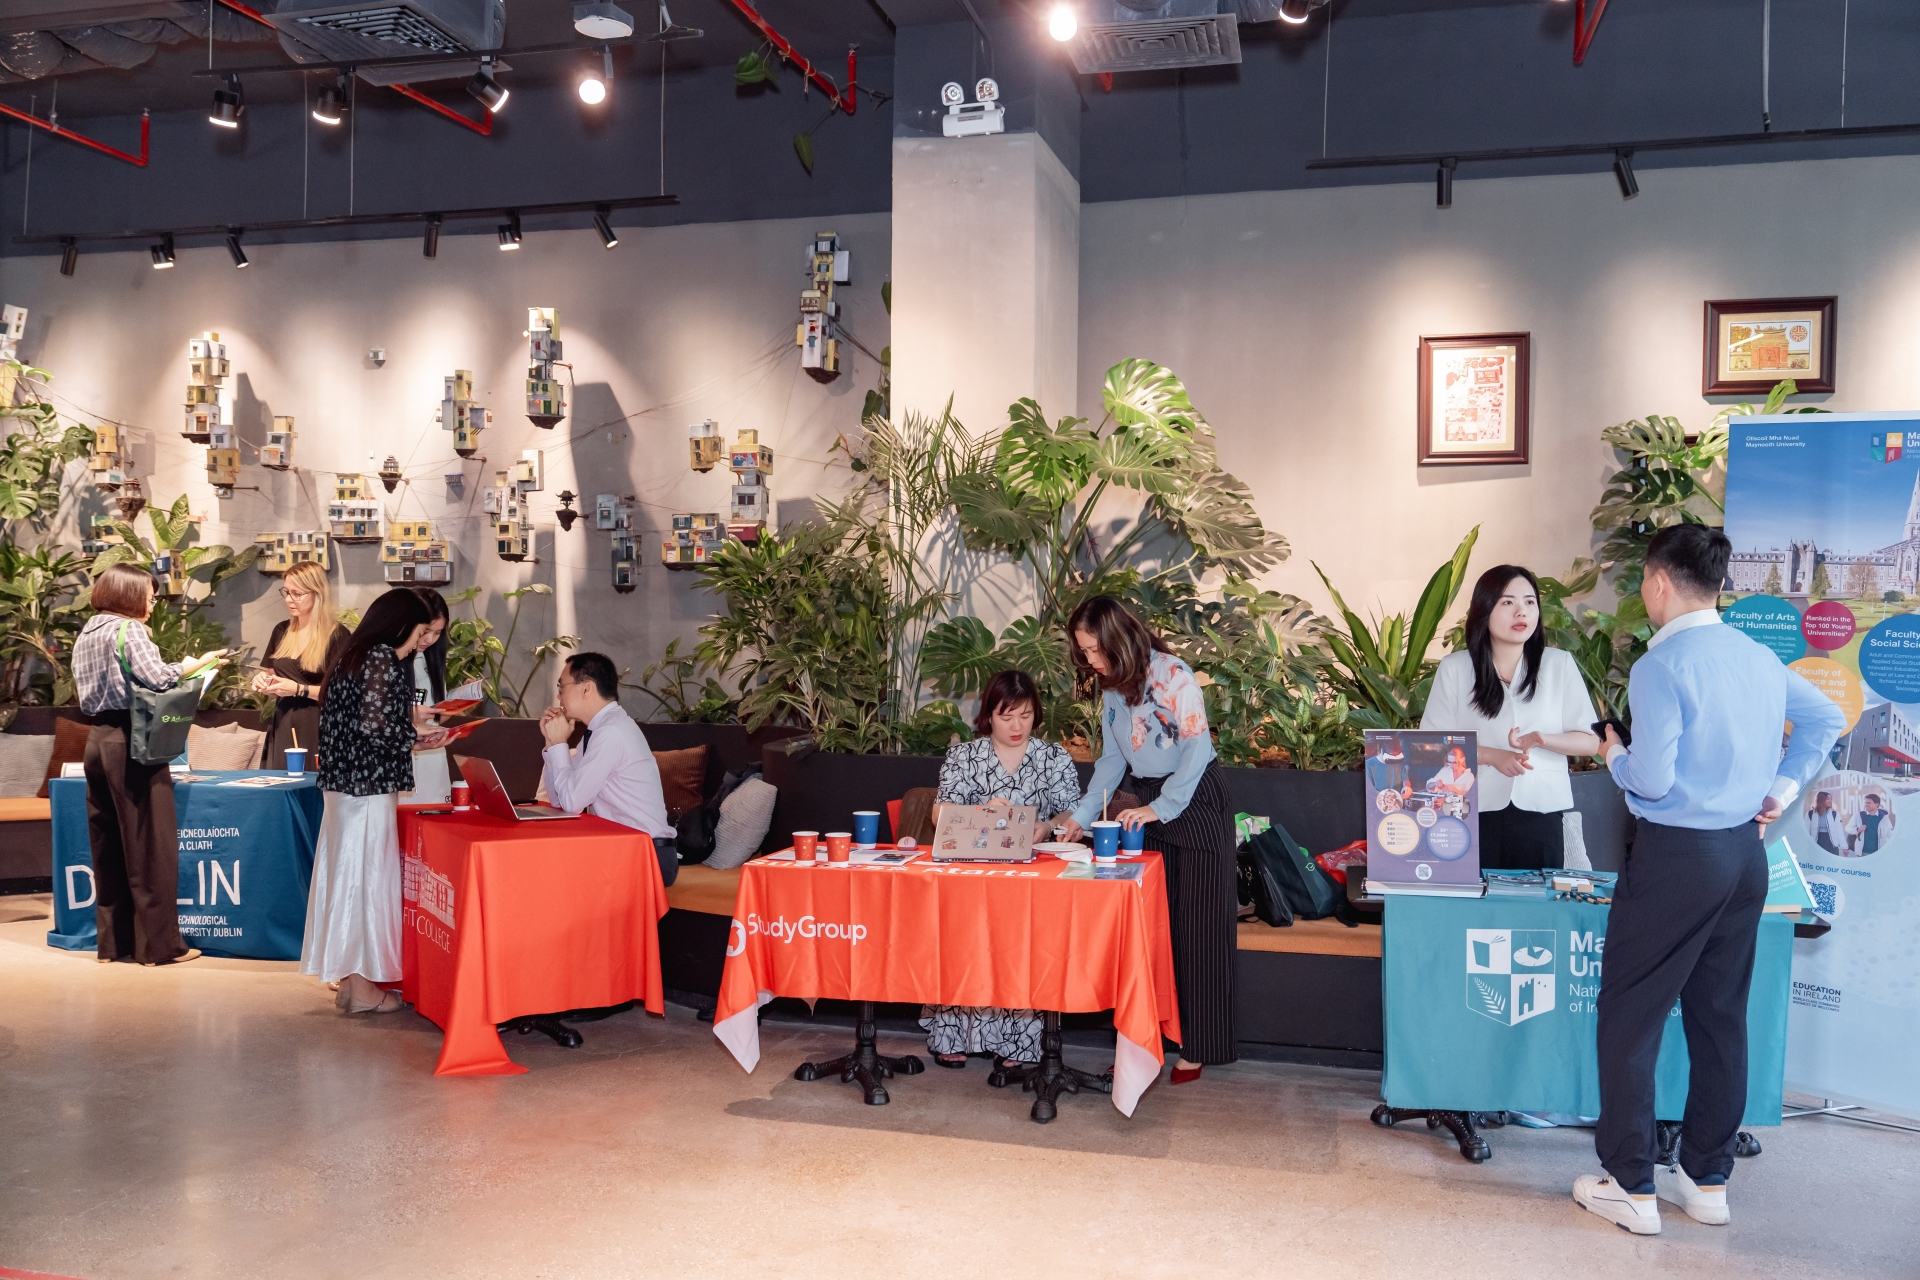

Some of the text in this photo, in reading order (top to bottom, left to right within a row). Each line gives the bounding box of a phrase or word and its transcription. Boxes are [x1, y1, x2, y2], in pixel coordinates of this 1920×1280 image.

[1730, 611, 1796, 621] Faculty of Arts
[1746, 621, 1798, 631] Humanities
[1885, 629, 1920, 640] Faculty
[1870, 638, 1920, 649] Social Sci
[1795, 666, 1842, 678] Faculty of
[1828, 679, 1847, 687] and
[1821, 688, 1845, 698] ering
[177, 825, 240, 839] EICNEOLAÍOCHTA
[186, 840, 213, 851] CLIATH
[1768, 859, 1790, 874] ynooth
[1798, 862, 1814, 870] tails
[1840, 868, 1872, 878] courses
[178, 914, 229, 925] ECHNOLOGICAL
[213, 927, 243, 937] DUBLIN
[403, 906, 451, 954] FIT COLLEGE
[747, 912, 868, 946] StudyGroup
[1570, 930, 1605, 953] Ma
[1570, 955, 1602, 977] Un
[1569, 983, 1601, 998] Nati
[1793, 981, 1842, 996] EDUCATION
[1792, 988, 1841, 1004] IN IRELAND
[1569, 1001, 1583, 1013] of
